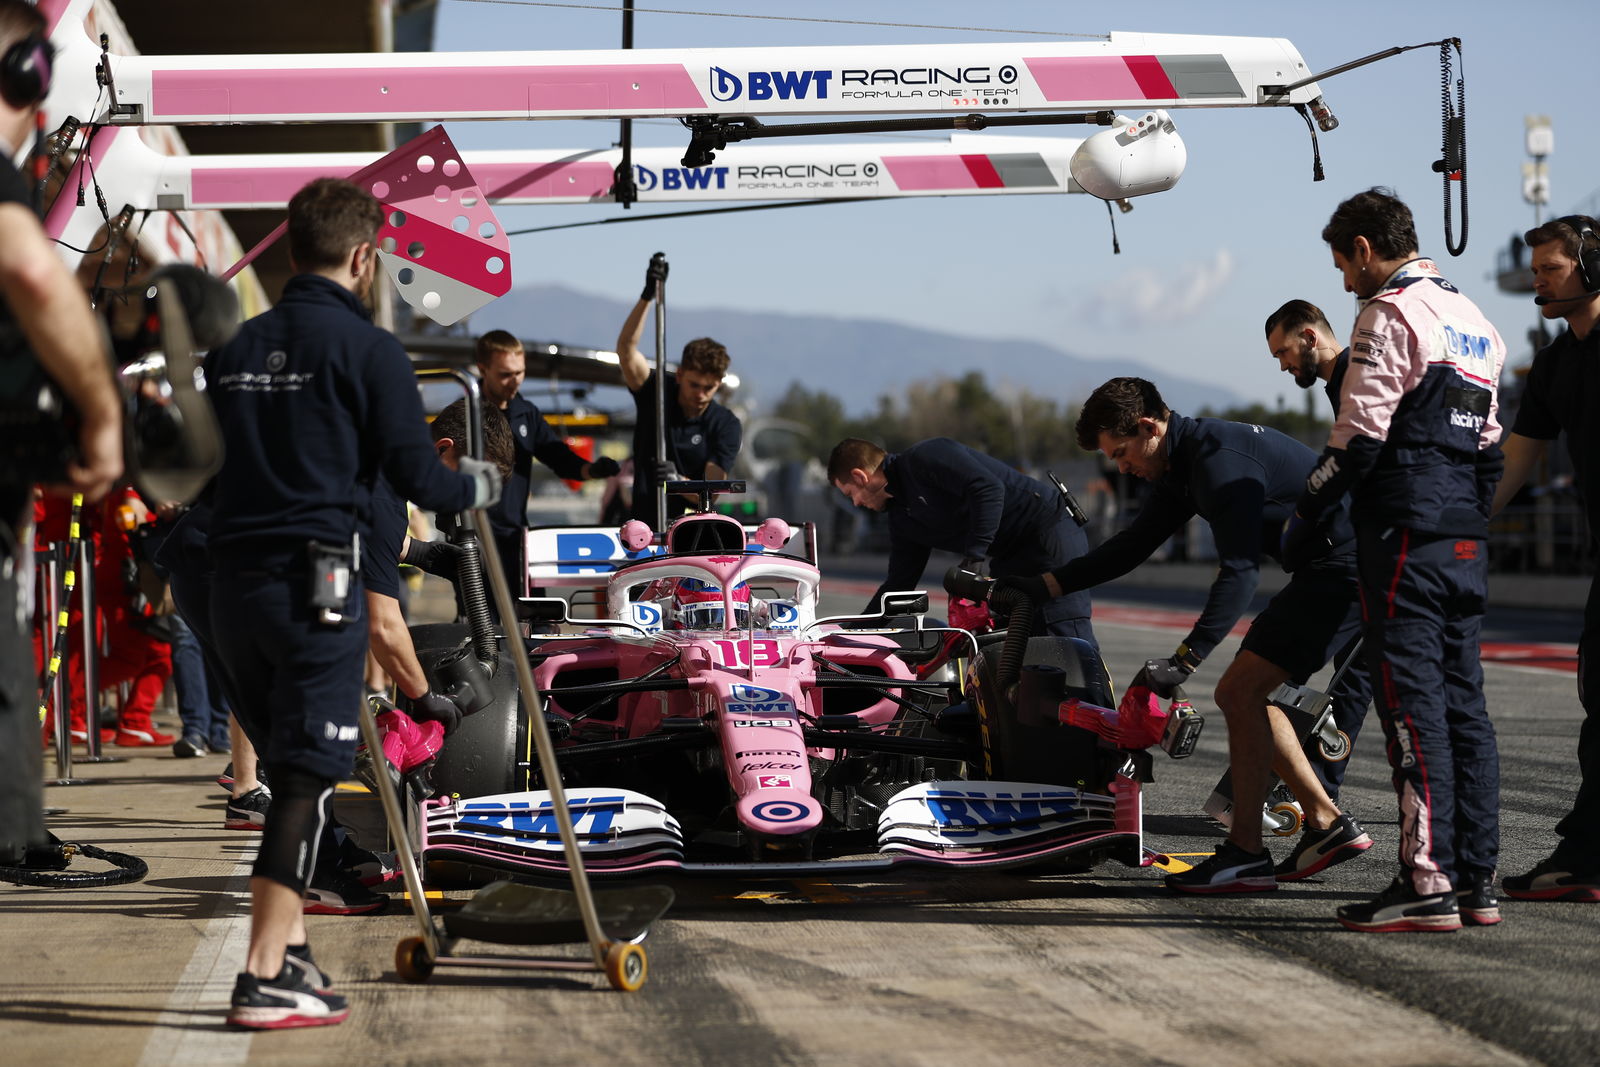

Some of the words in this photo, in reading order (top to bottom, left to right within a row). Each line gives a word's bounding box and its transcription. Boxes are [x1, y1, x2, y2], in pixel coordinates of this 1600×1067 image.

[748, 70, 833, 100] BWT
[842, 67, 990, 86] RACING
[842, 90, 923, 99] FORMULA
[928, 89, 962, 97] ONE
[972, 88, 1018, 96] TEAM
[662, 167, 729, 190] BWT
[738, 164, 856, 179] RACING
[738, 181, 803, 190] FORMULA
[842, 180, 879, 188] TEAM
[1310, 455, 1340, 490] BWT
[709, 640, 781, 668] 18
[727, 703, 789, 712] BWT
[454, 796, 625, 845] BWT
[927, 790, 1080, 837] BWT
